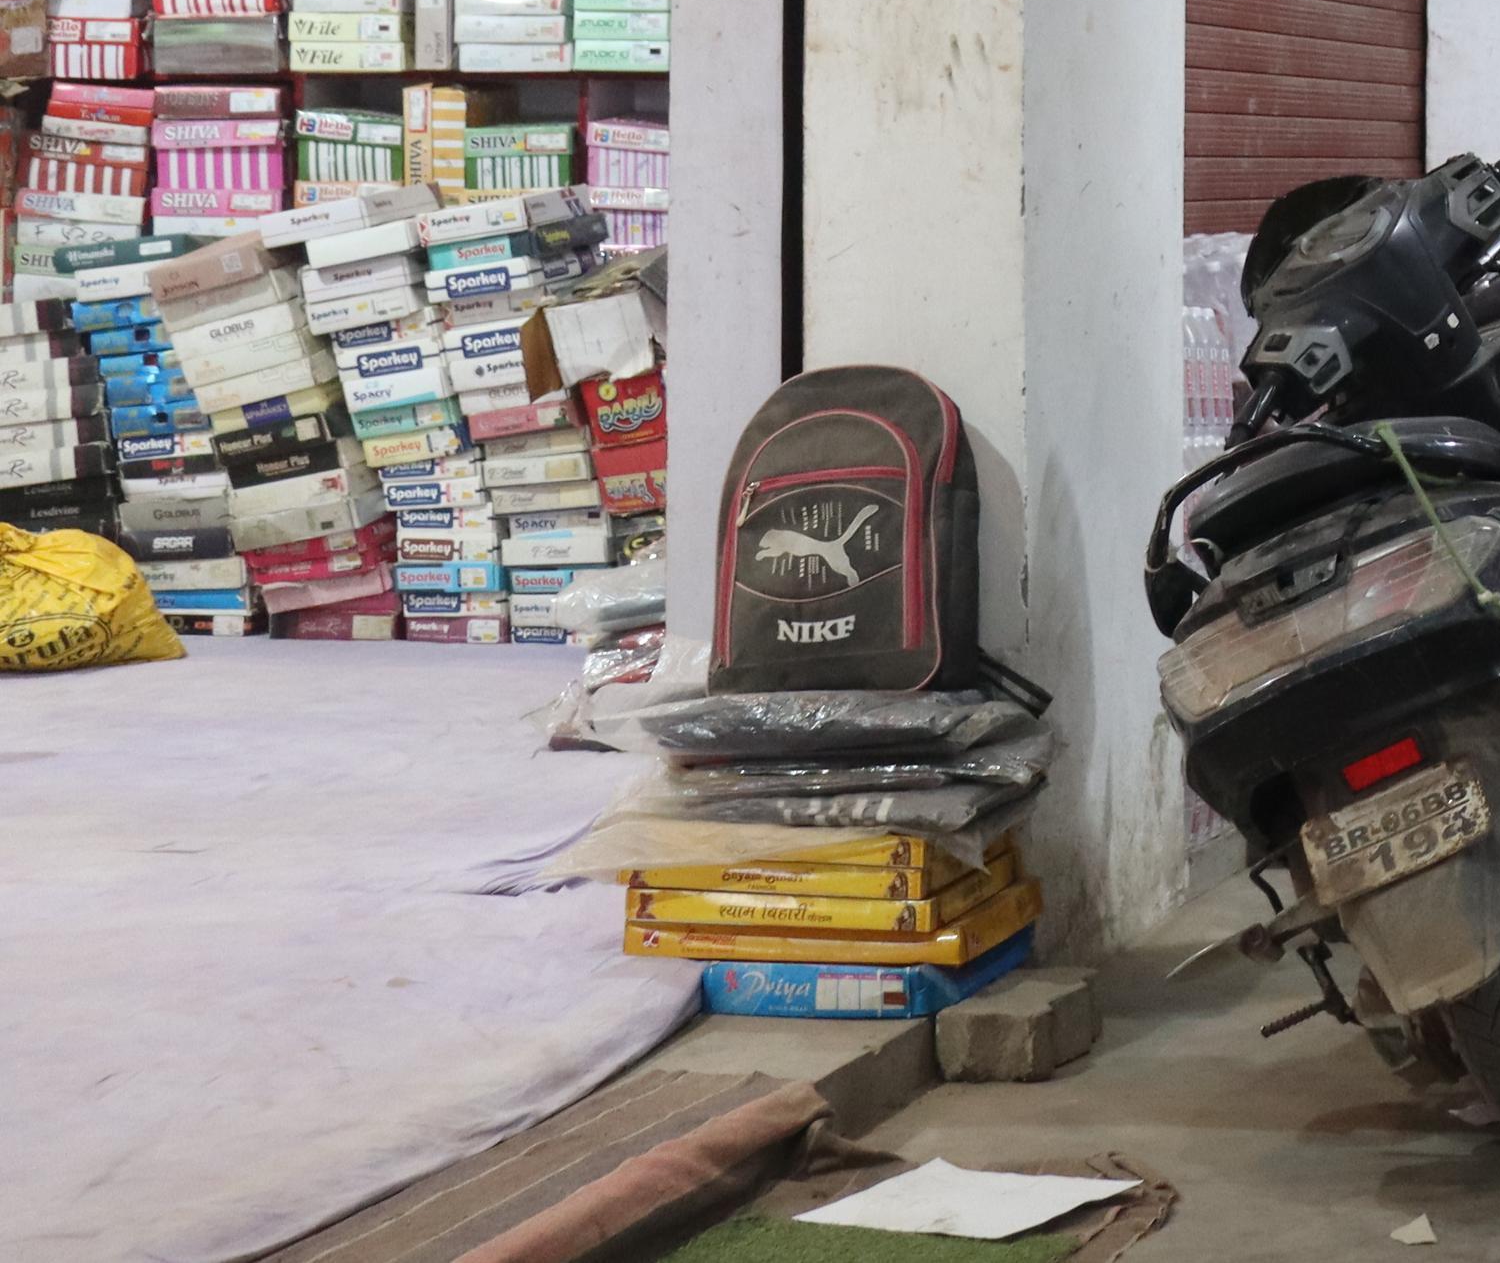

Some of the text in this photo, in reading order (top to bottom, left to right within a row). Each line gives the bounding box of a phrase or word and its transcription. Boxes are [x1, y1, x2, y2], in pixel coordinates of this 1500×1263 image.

[164, 125, 220, 140] SHIVA
[470, 136, 518, 150] SHIVA
[161, 192, 219, 207] SHIVA
[456, 243, 506, 260] Sparkey
[20, 253, 53, 267] SHI
[448, 273, 507, 290] Sparkey
[210, 319, 255, 339] GLOBUS
[358, 349, 419, 371] Sparkey
[123, 438, 173, 453] Sparkey
[372, 440, 421, 457] Sparkey
[388, 486, 438, 501] Sparkey
[402, 541, 451, 557] Sparkey
[408, 594, 458, 609] Sparkey
[741, 971, 812, 1002] Priya
